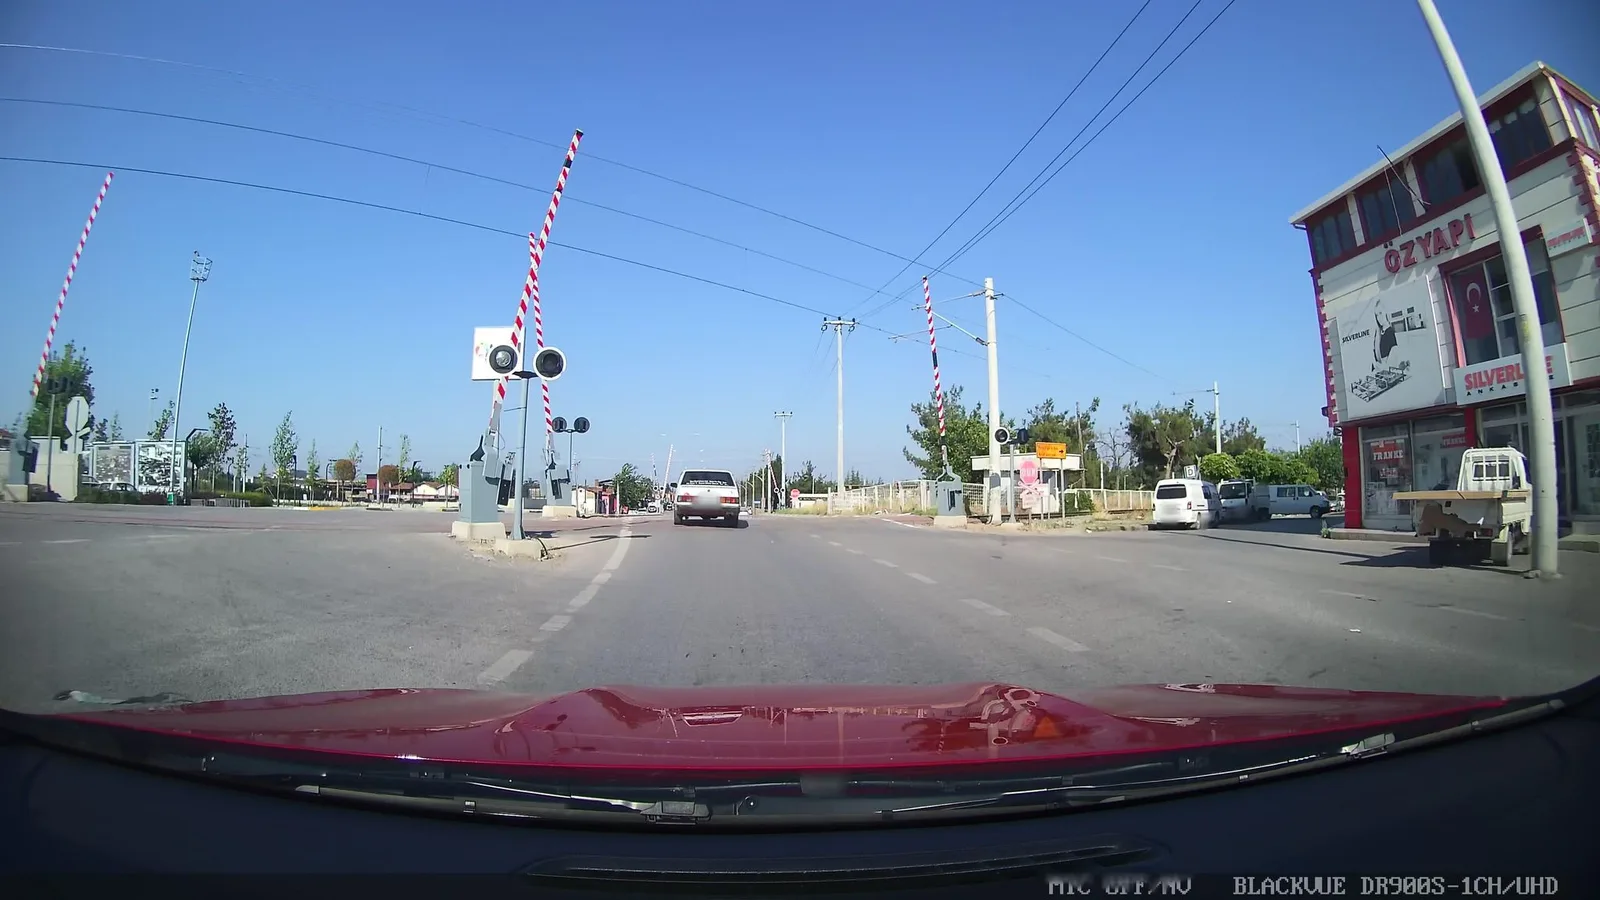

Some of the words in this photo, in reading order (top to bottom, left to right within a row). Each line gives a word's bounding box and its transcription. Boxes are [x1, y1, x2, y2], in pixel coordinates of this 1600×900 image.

[1384, 213, 1475, 273] ÖZYAPI
[1342, 329, 1370, 344] SILVERLINE
[1464, 355, 1553, 391] SILVERLE
[1467, 375, 1554, 397] ANKASE
[1373, 449, 1404, 461] FRANKE
